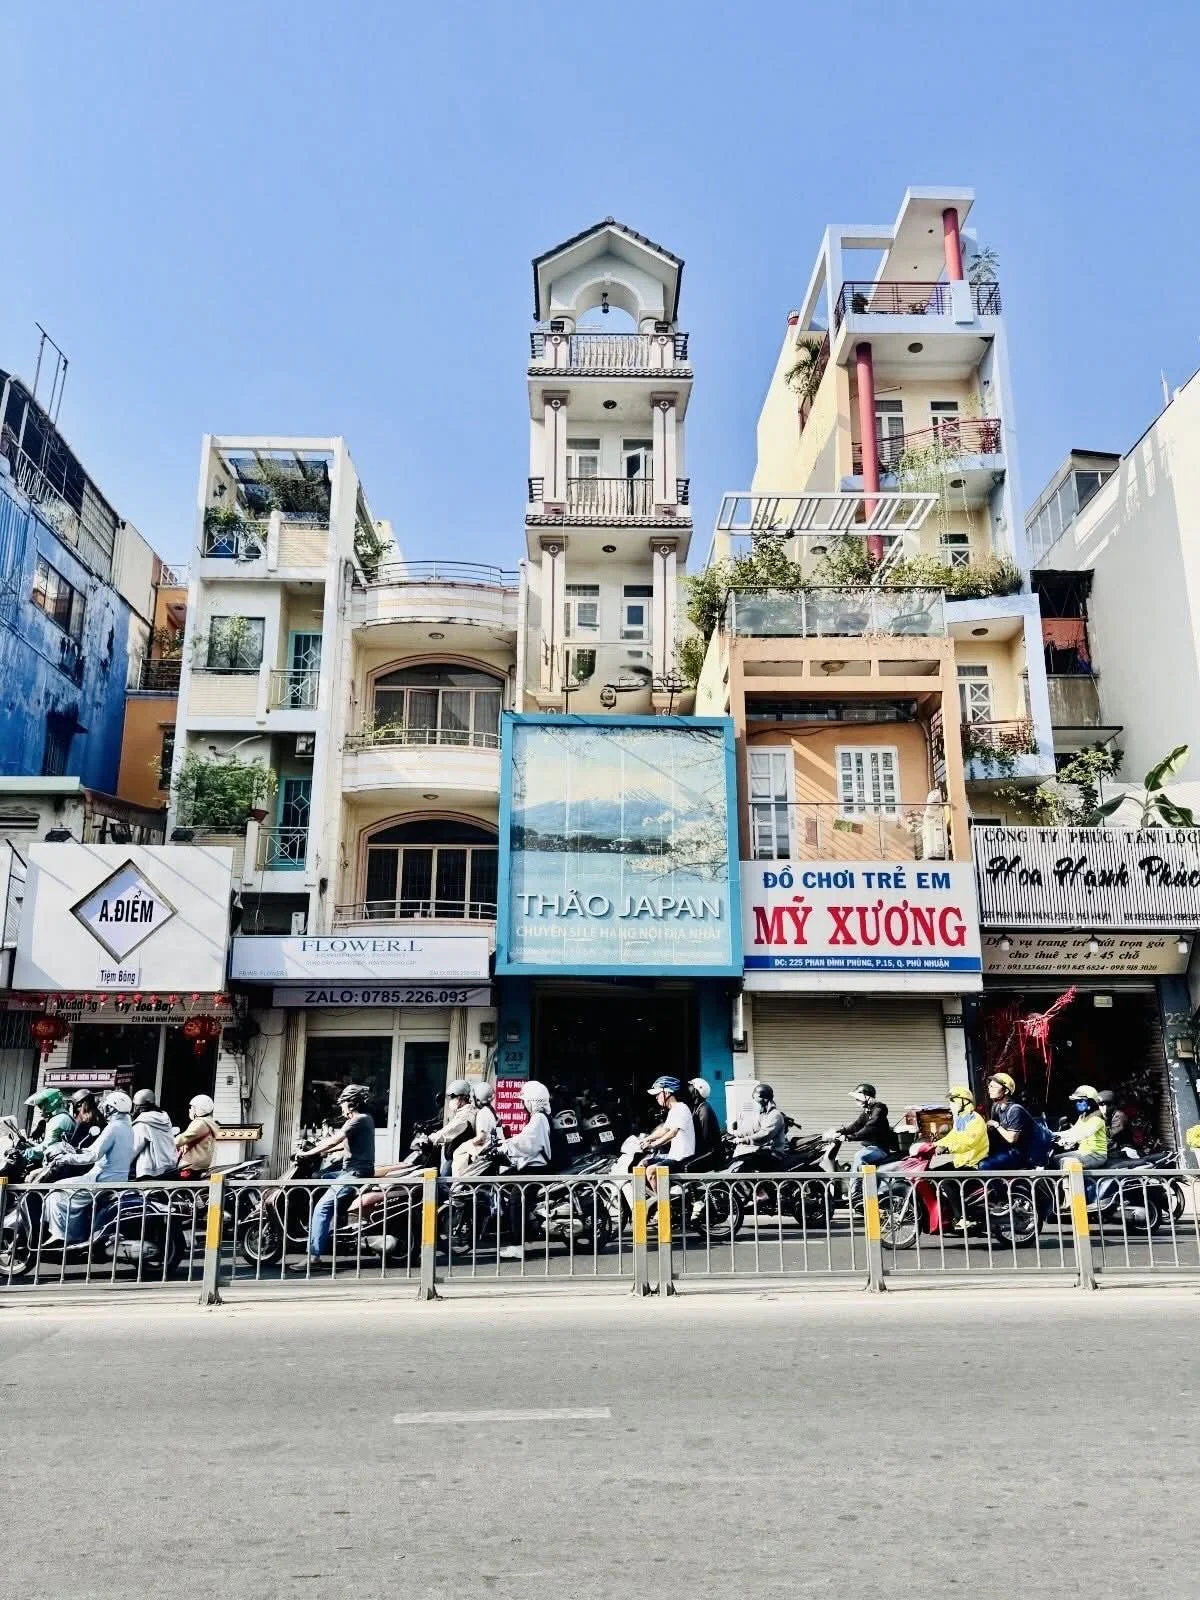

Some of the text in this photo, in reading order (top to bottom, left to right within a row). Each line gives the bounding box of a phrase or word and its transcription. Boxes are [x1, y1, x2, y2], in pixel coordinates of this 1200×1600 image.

[984, 828, 1028, 842] CÔNG
[1038, 832, 1058, 842] TY
[763, 865, 950, 889] ĐỒ CHƠI TRẺ EM
[986, 856, 1200, 895] Hoa Hạnh Phúc
[99, 890, 154, 922] A.ĐIỂM
[517, 890, 720, 919] THẢO JAPAN
[753, 896, 967, 946] MỸ XƯƠNG
[302, 939, 423, 952] FLOWER.L
[984, 937, 1014, 948] Dịh
[1020, 940, 1032, 948] vụ
[1036, 938, 1068, 948] trang
[1120, 938, 1142, 949] trọn
[1146, 937, 1166, 948] gói
[1008, 950, 1030, 959] cho
[1034, 950, 1060, 959] thuê
[1100, 952, 1114, 960] 45
[1118, 950, 1140, 960] chỗ
[789, 958, 803, 966] 225
[804, 958, 824, 966] PHAN
[826, 957, 844, 967] ĐÌNH
[846, 958, 874, 968] PHÙNG,
[876, 960, 895, 968] P.15,
[896, 960, 905, 968] Q.
[924, 958, 950, 968] NHUẬN
[100, 970, 117, 984] Tiệm
[946, 1016, 962, 1024] 225
